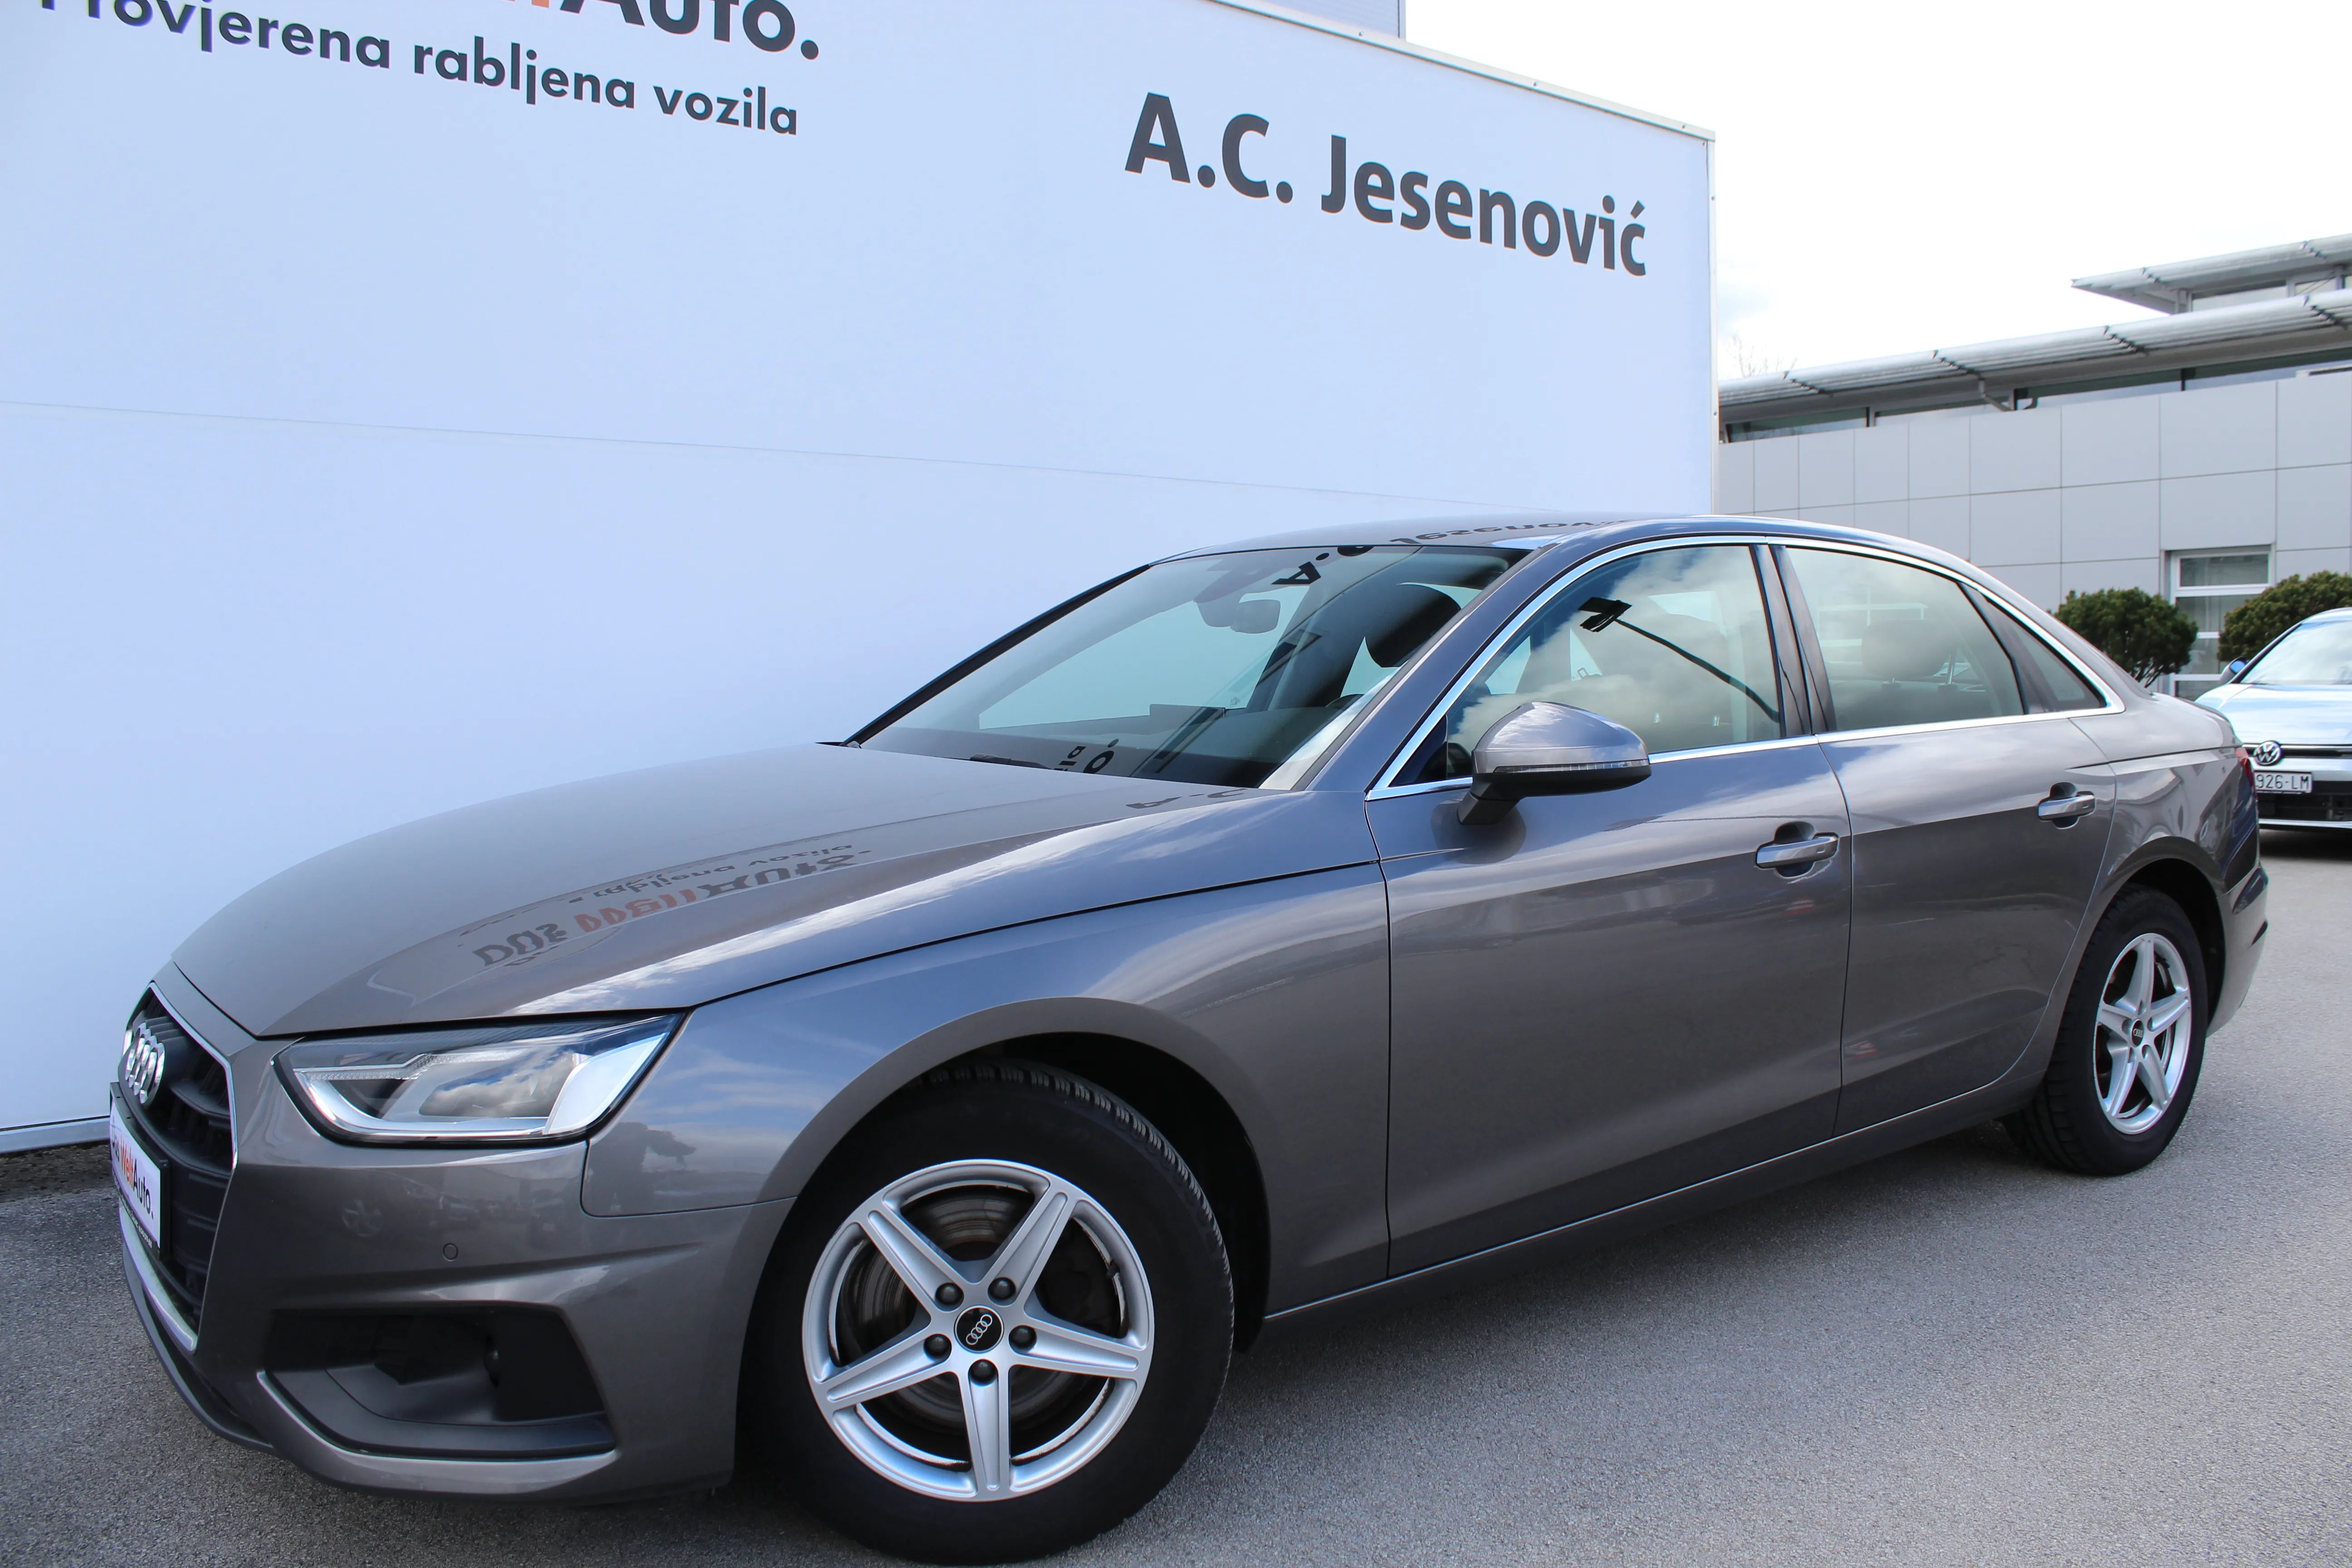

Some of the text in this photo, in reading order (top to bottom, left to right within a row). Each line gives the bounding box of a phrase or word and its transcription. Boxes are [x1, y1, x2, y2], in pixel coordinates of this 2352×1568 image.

[414, 35, 635, 109] rabljena
[652, 85, 798, 136] vozila
[1124, 92, 1647, 277] A.C. Jesenović
[120, 1135, 154, 1220] WeltAuto.
